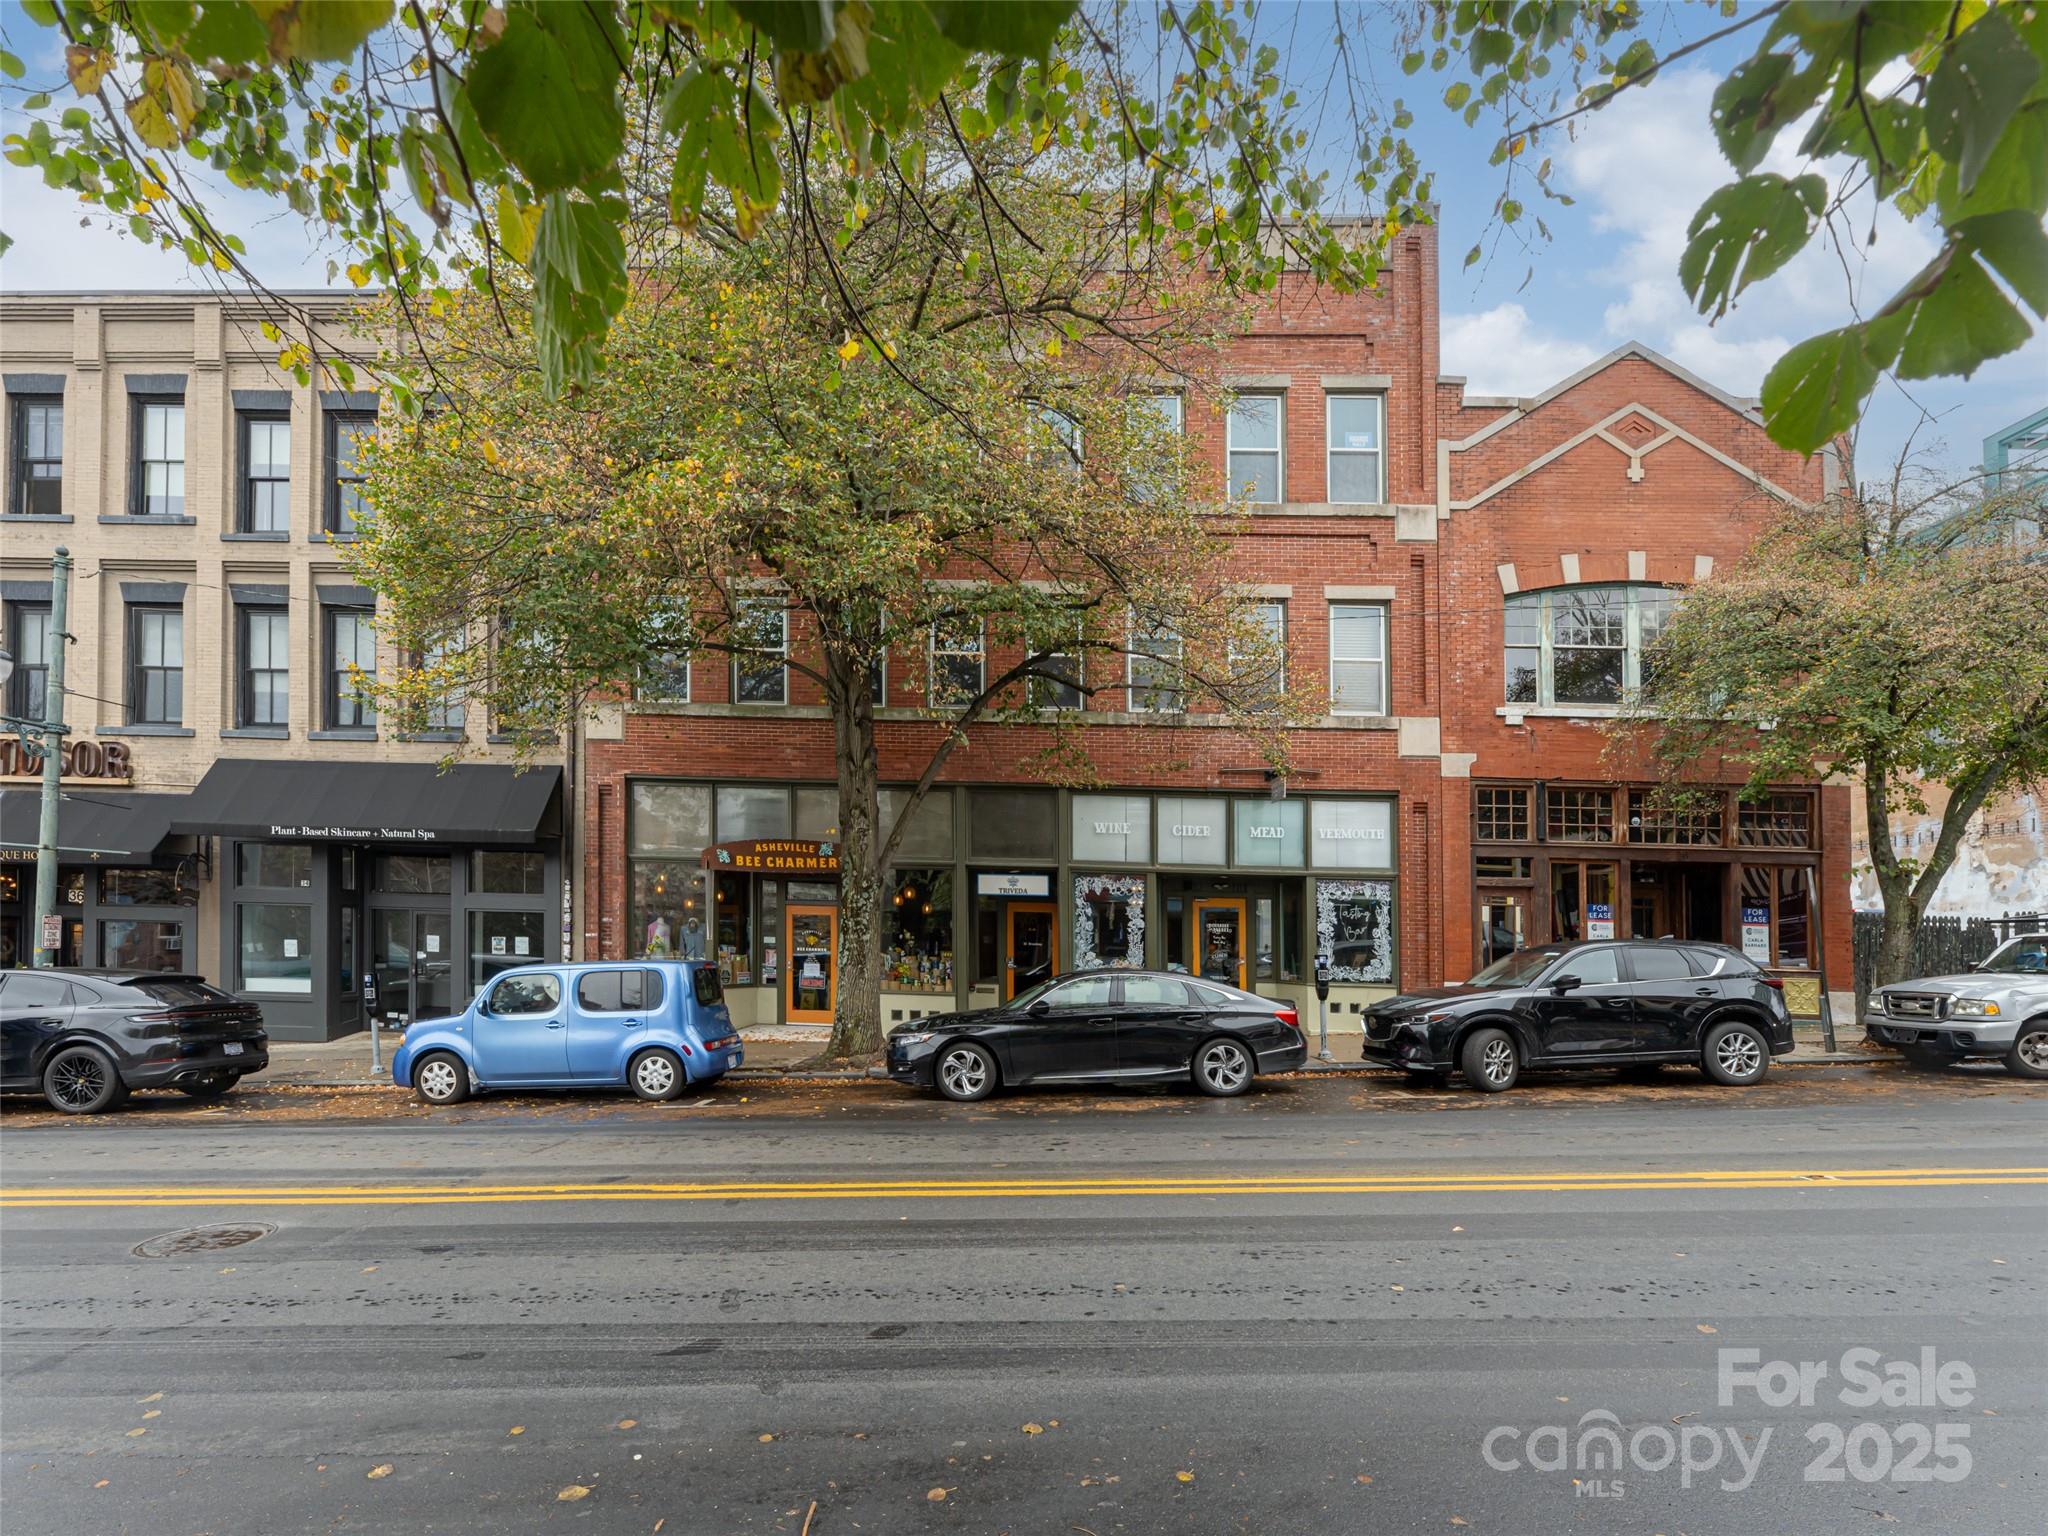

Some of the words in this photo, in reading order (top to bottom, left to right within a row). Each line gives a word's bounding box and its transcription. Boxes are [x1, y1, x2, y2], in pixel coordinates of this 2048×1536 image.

[330, 828, 371, 838] Skincare
[381, 828, 416, 838] Natural
[417, 829, 435, 840] Spa
[1094, 822, 1132, 835] WINE
[1172, 825, 1211, 837] CIDER
[1250, 827, 1285, 839] MEAD
[1319, 828, 1385, 840] VERMOUTH
[755, 843, 815, 853] ASHEVILLE
[735, 855, 761, 867] BEE
[766, 856, 838, 869] CHARMER
[69, 889, 84, 902] 36
[998, 887, 1029, 895] TRIVEDA
[1334, 904, 1371, 922] Tasting
[1592, 904, 1608, 912] FOR
[1747, 908, 1763, 916] FOR
